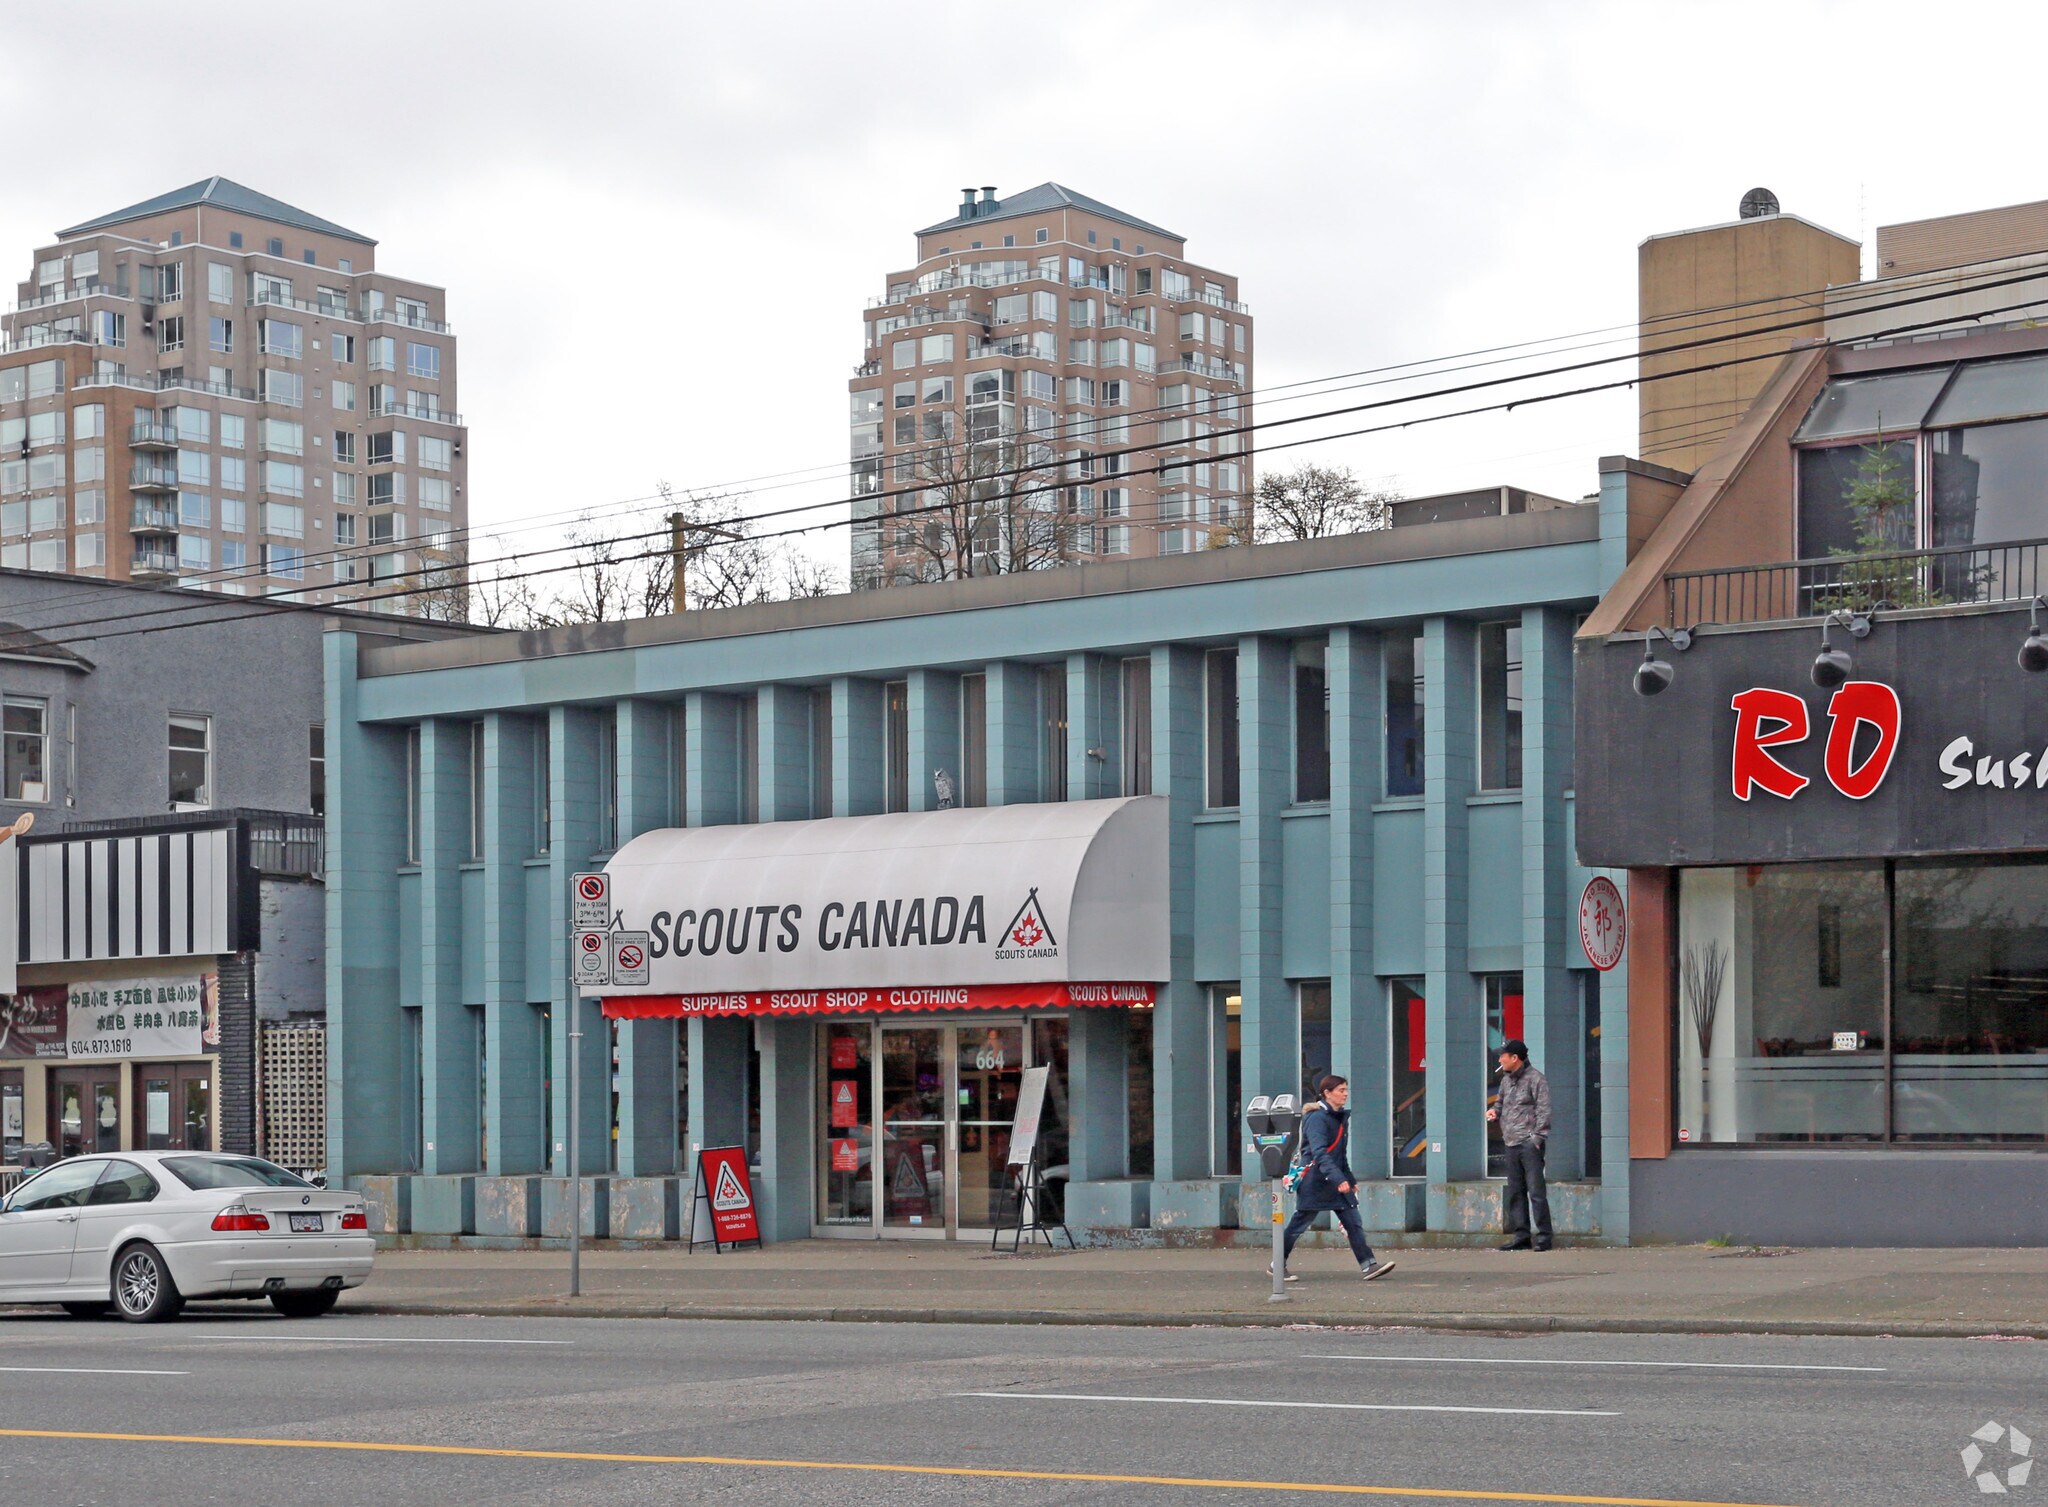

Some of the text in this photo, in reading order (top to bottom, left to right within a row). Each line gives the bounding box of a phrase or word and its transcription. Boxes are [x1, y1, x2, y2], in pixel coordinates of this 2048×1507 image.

[1731, 681, 1902, 801] RO
[1597, 882, 1618, 902] SUSHI
[649, 895, 987, 958] SCOUTS CANADA
[995, 948, 1058, 960] SCOUTS CANADA
[1583, 925, 1623, 965] JAPANESE BISTRO
[71, 991, 108, 1009] 中原小吃
[113, 988, 152, 1006] 手工面食
[682, 989, 968, 1012] SUPPLIES SCOUT SHOP CLOTHING
[1068, 985, 1108, 1001] SCOUTS
[133, 1012, 163, 1030] 羊肉串
[71, 1038, 132, 1054] 604.873.1618
[975, 1050, 1005, 1070] 664
